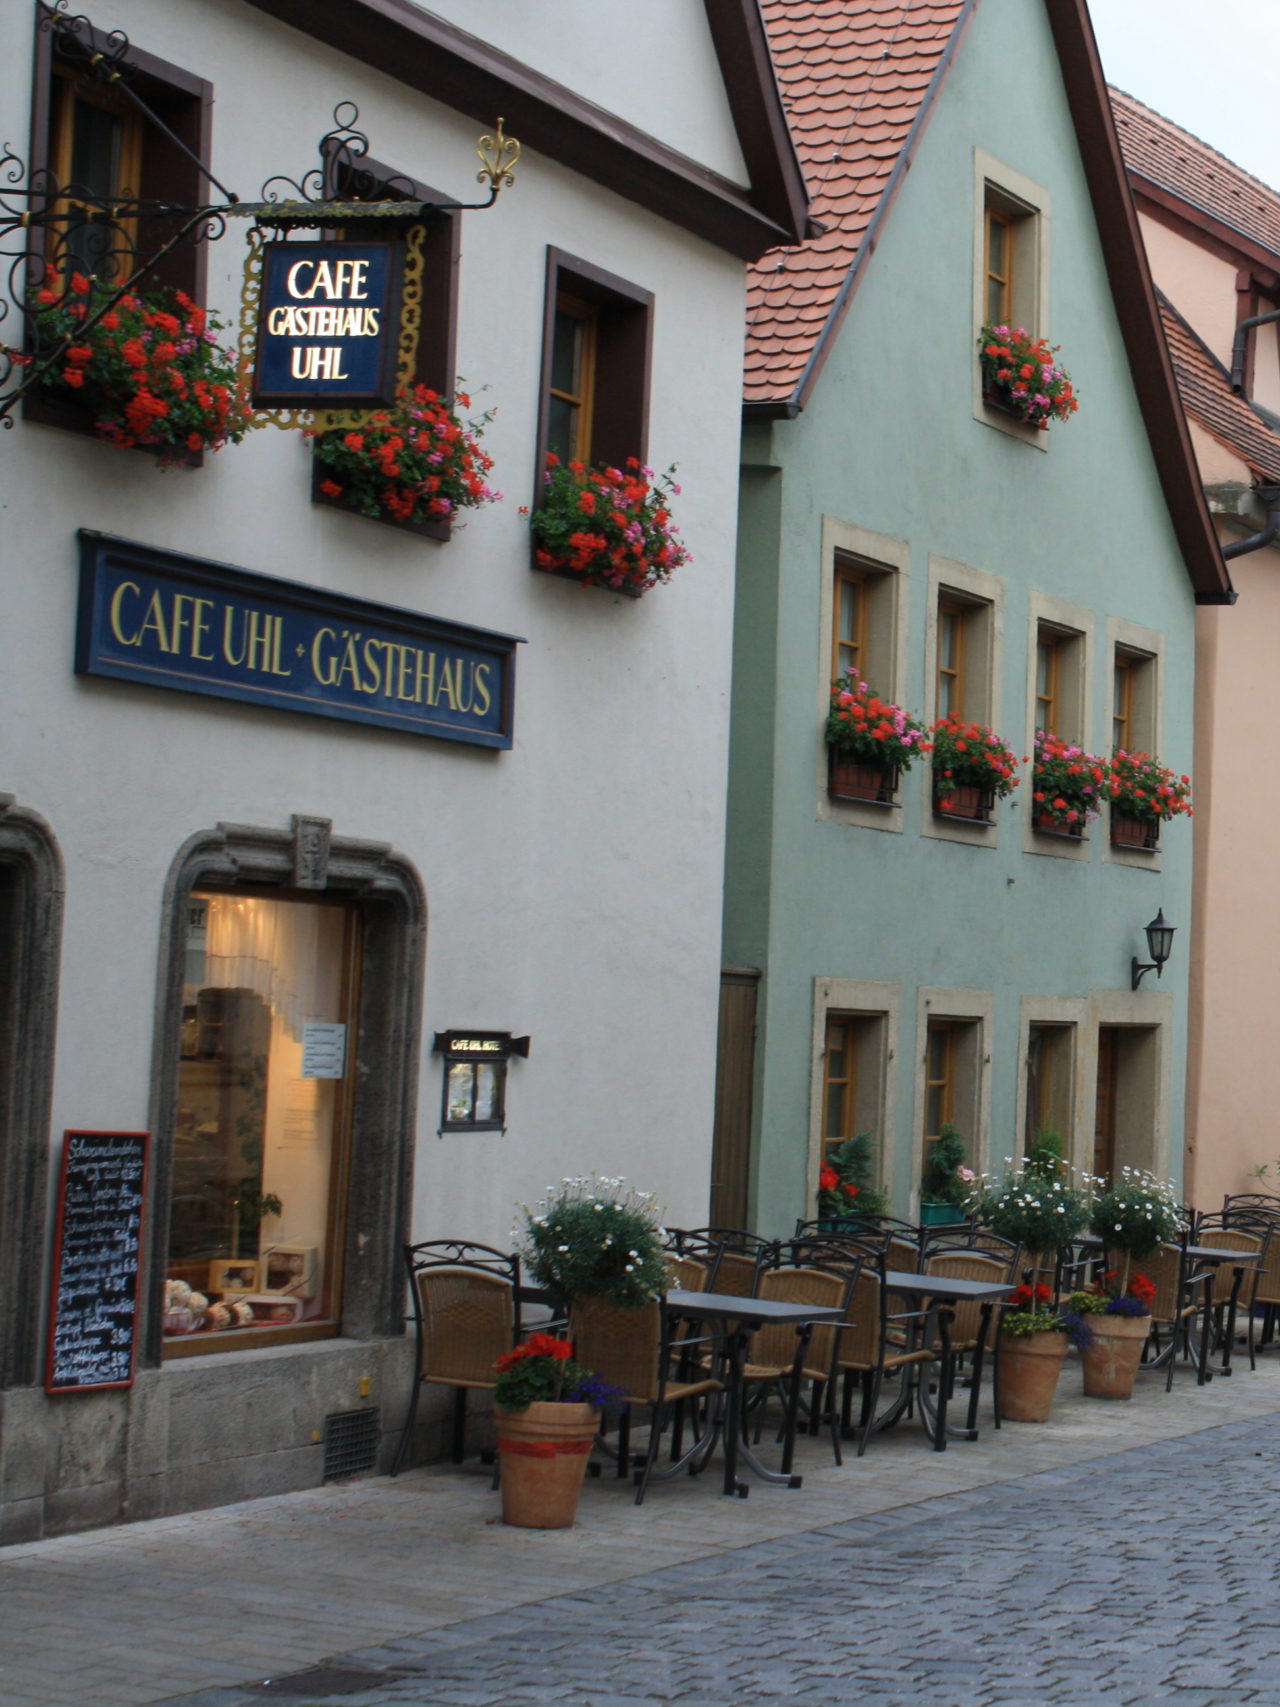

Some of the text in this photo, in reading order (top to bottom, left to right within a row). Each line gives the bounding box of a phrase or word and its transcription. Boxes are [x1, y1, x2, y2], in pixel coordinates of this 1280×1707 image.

[286, 259, 370, 300] CAFE
[291, 346, 349, 380] UHL
[110, 581, 491, 716] CAFE UHL GÄSTEHAUS
[451, 1039, 469, 1051] CAFE
